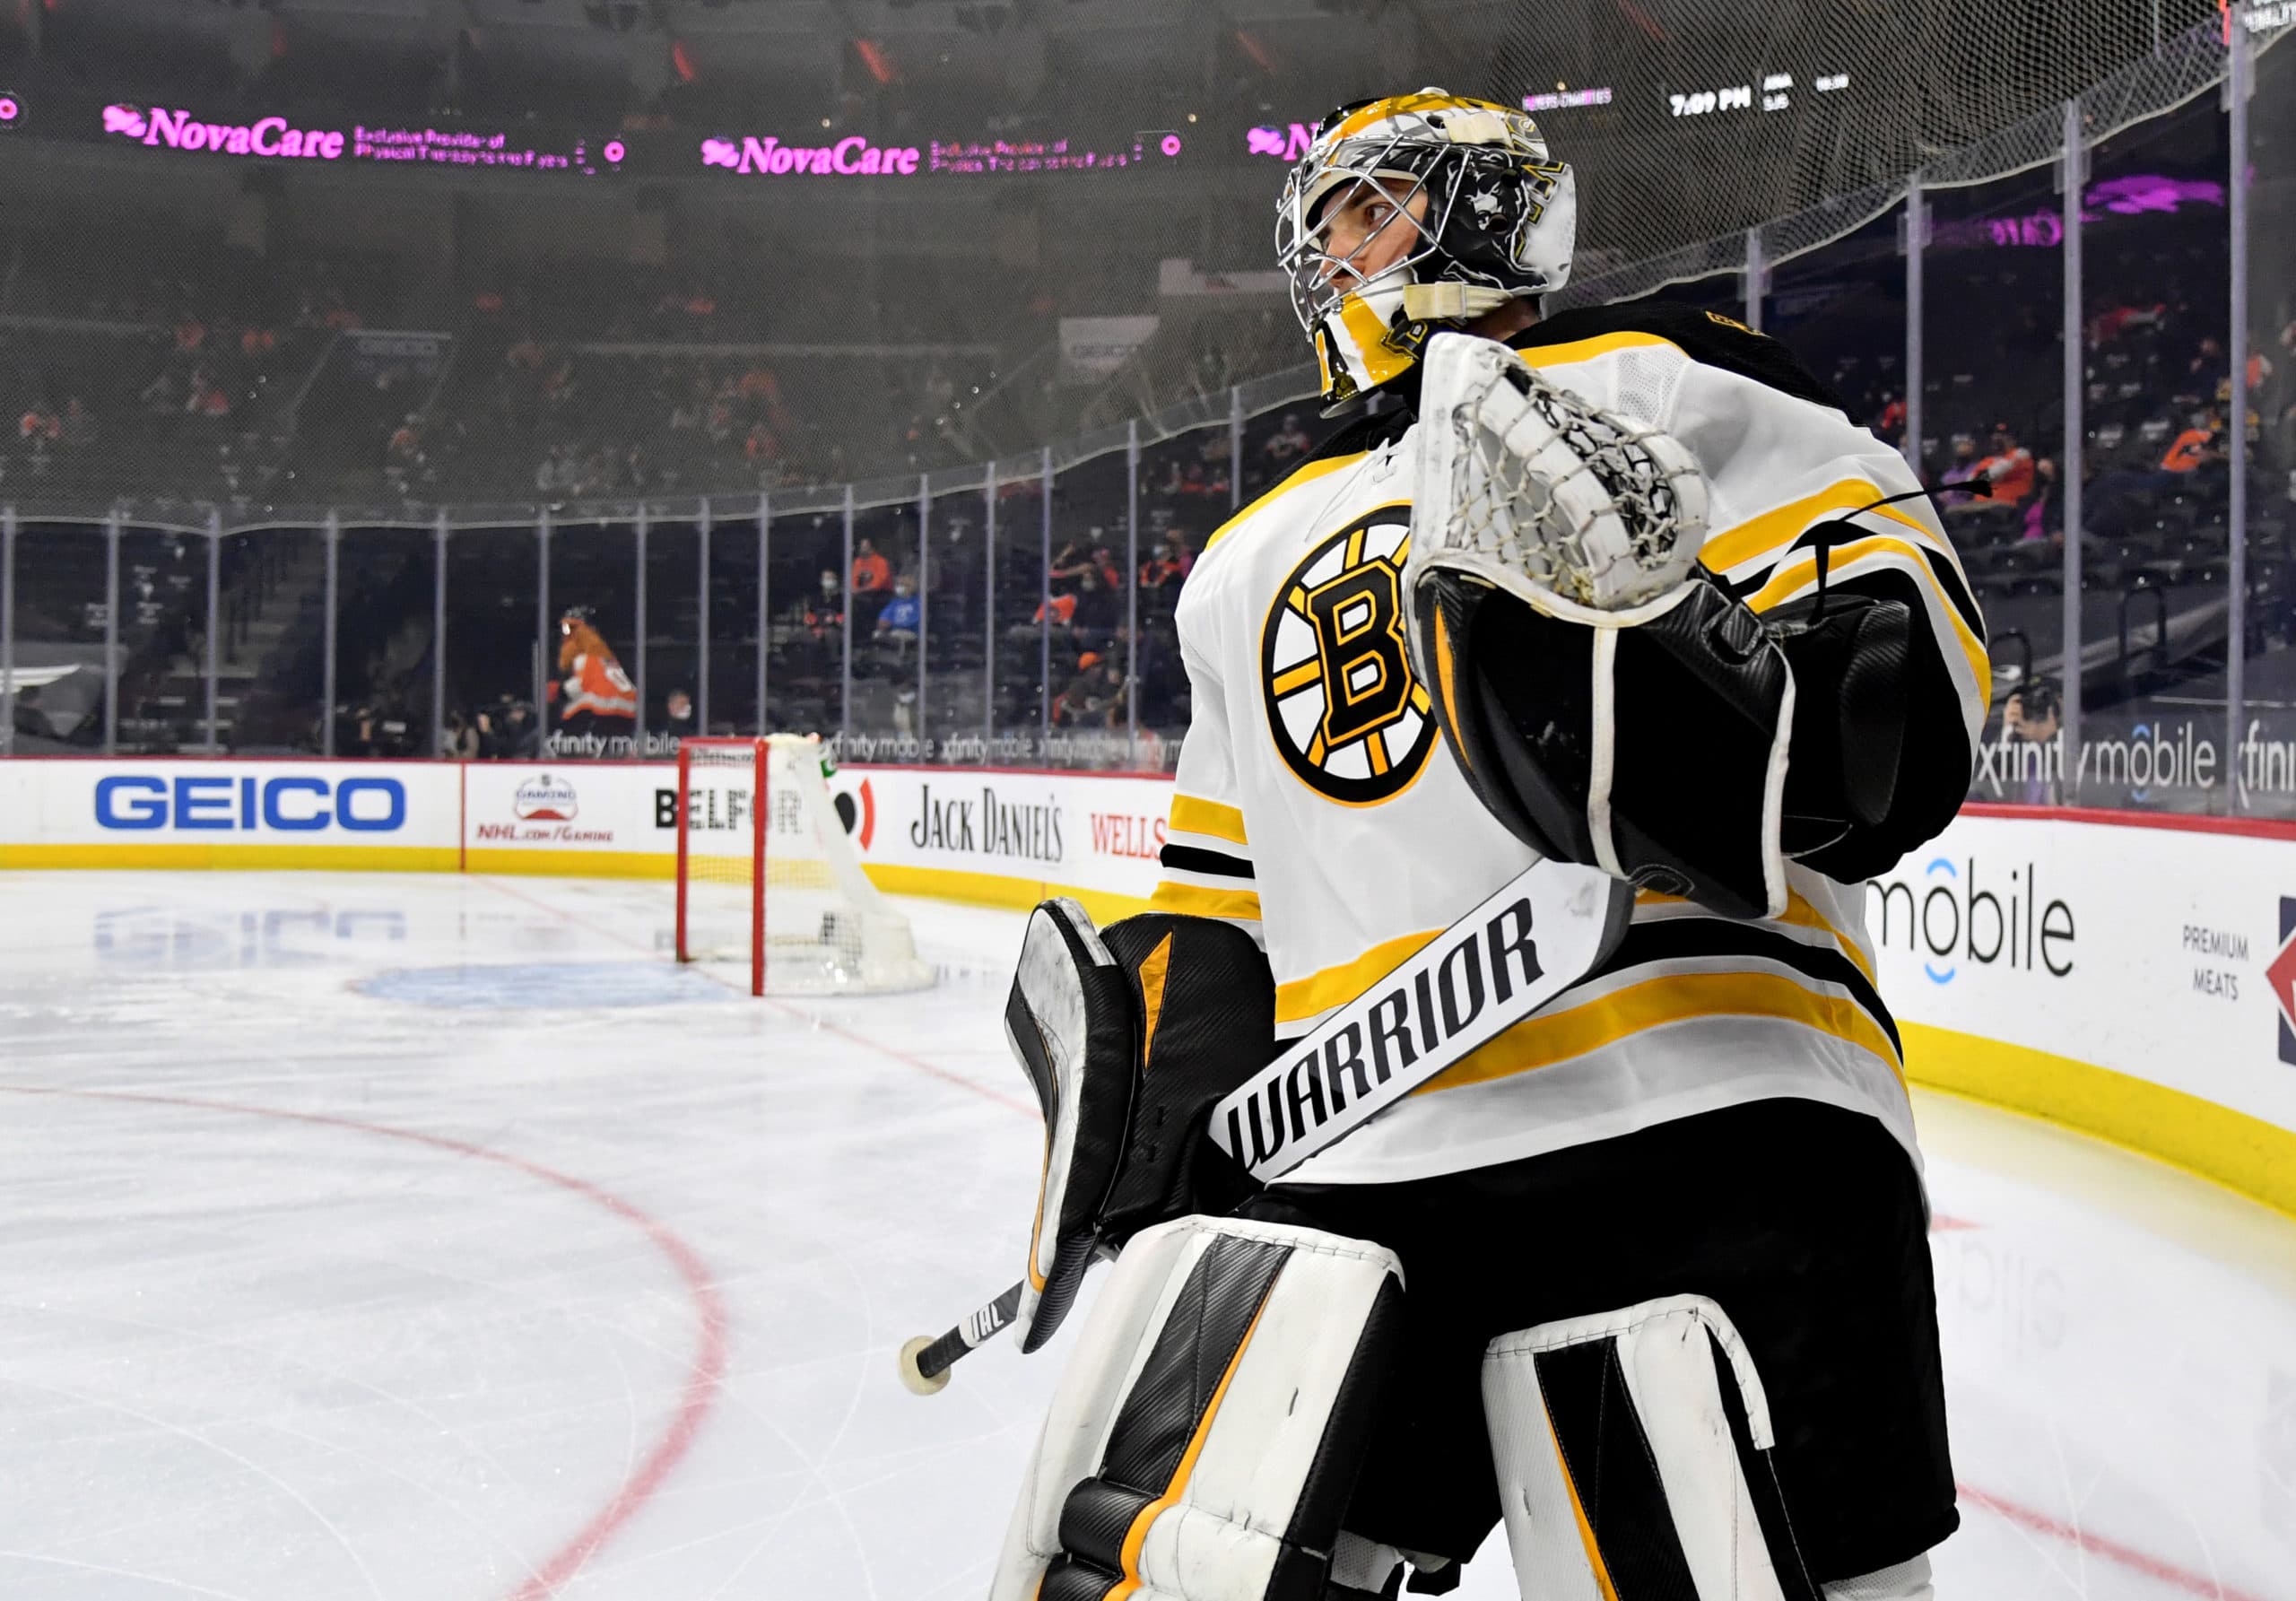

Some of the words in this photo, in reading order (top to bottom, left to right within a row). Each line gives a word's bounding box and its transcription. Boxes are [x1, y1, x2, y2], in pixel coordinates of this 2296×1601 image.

[1718, 85, 1752, 111] PM
[143, 107, 345, 159] NovaCare
[736, 136, 920, 174] NovaCare
[2094, 721, 2217, 791] mobile
[95, 775, 406, 831] GEICO
[656, 789, 802, 833] BELFR
[910, 784, 975, 852] JACK
[1091, 812, 1167, 861] WELLS
[1866, 857, 2075, 979] mobile
[2182, 924, 2249, 961] PREMIUM
[2193, 968, 2239, 1002] MEATS
[1227, 897, 1545, 1170] WARRIOR
